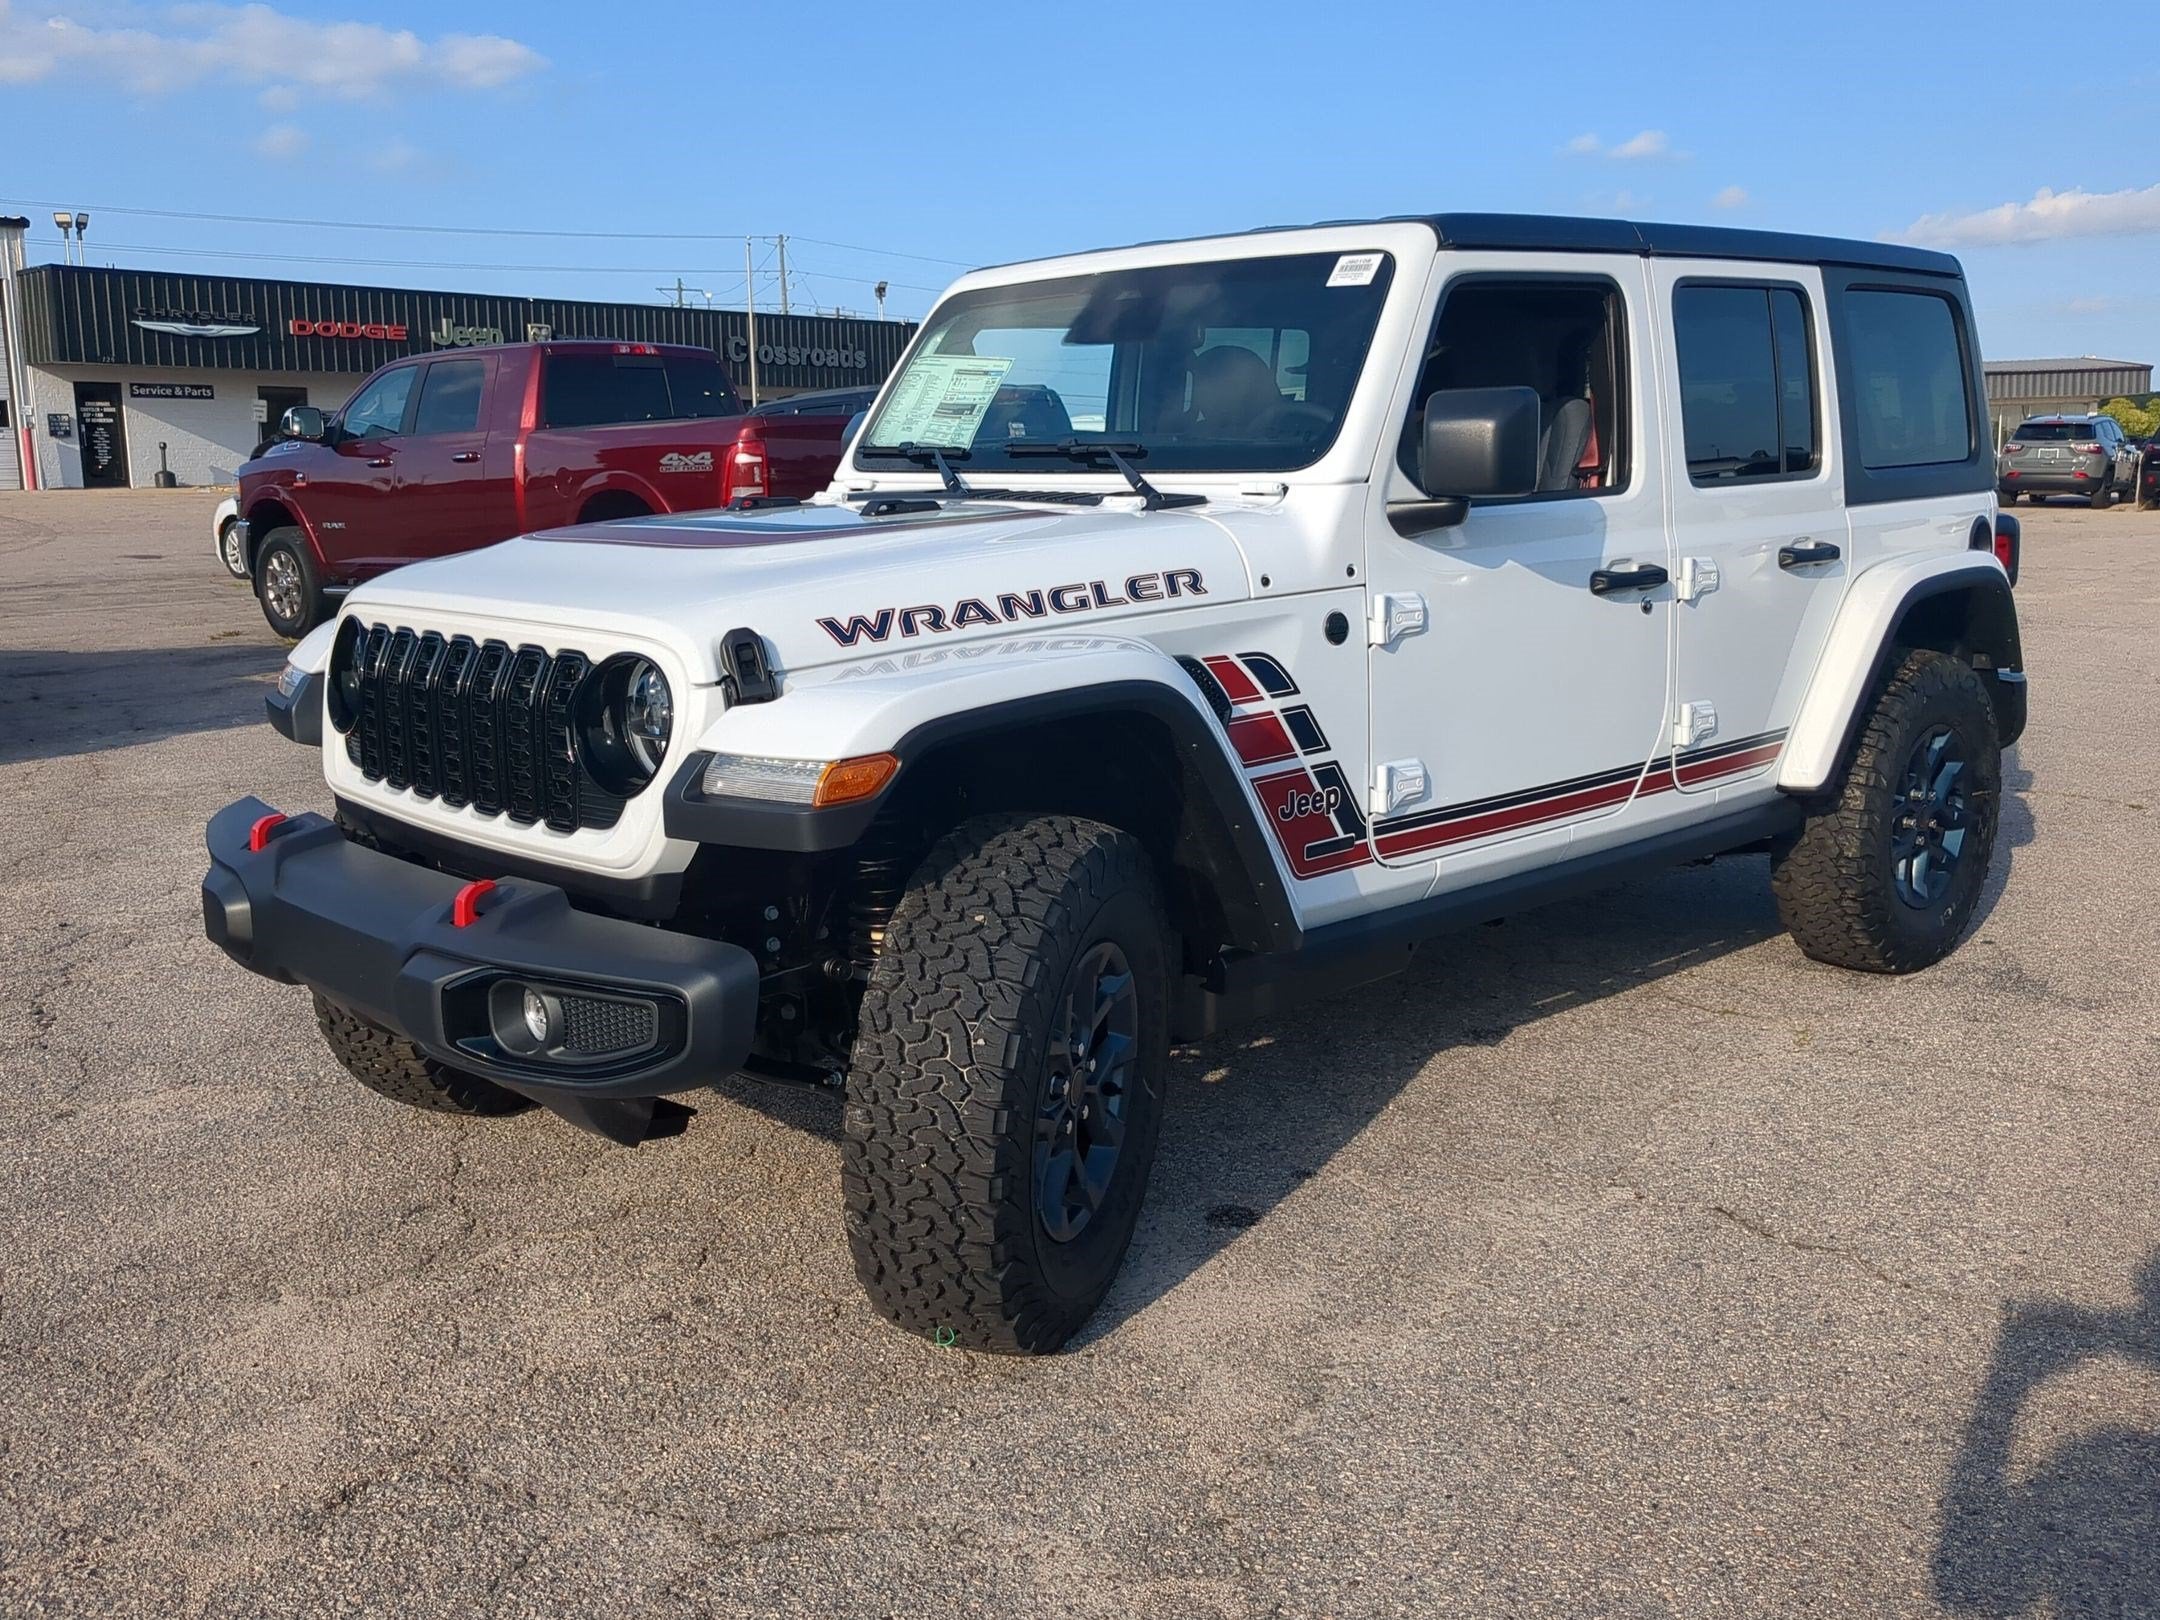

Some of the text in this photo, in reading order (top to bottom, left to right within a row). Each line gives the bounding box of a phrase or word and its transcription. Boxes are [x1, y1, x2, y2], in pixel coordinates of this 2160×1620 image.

[133, 306, 257, 322] CHRYSLER
[289, 319, 408, 340] DODGE
[431, 318, 504, 346] Jeep
[727, 336, 867, 369] Cossroads
[132, 385, 212, 397] Service & Parts
[659, 451, 715, 466] 4x4
[817, 567, 1209, 647] WRANGLER
[1279, 786, 1341, 821] Jeep
